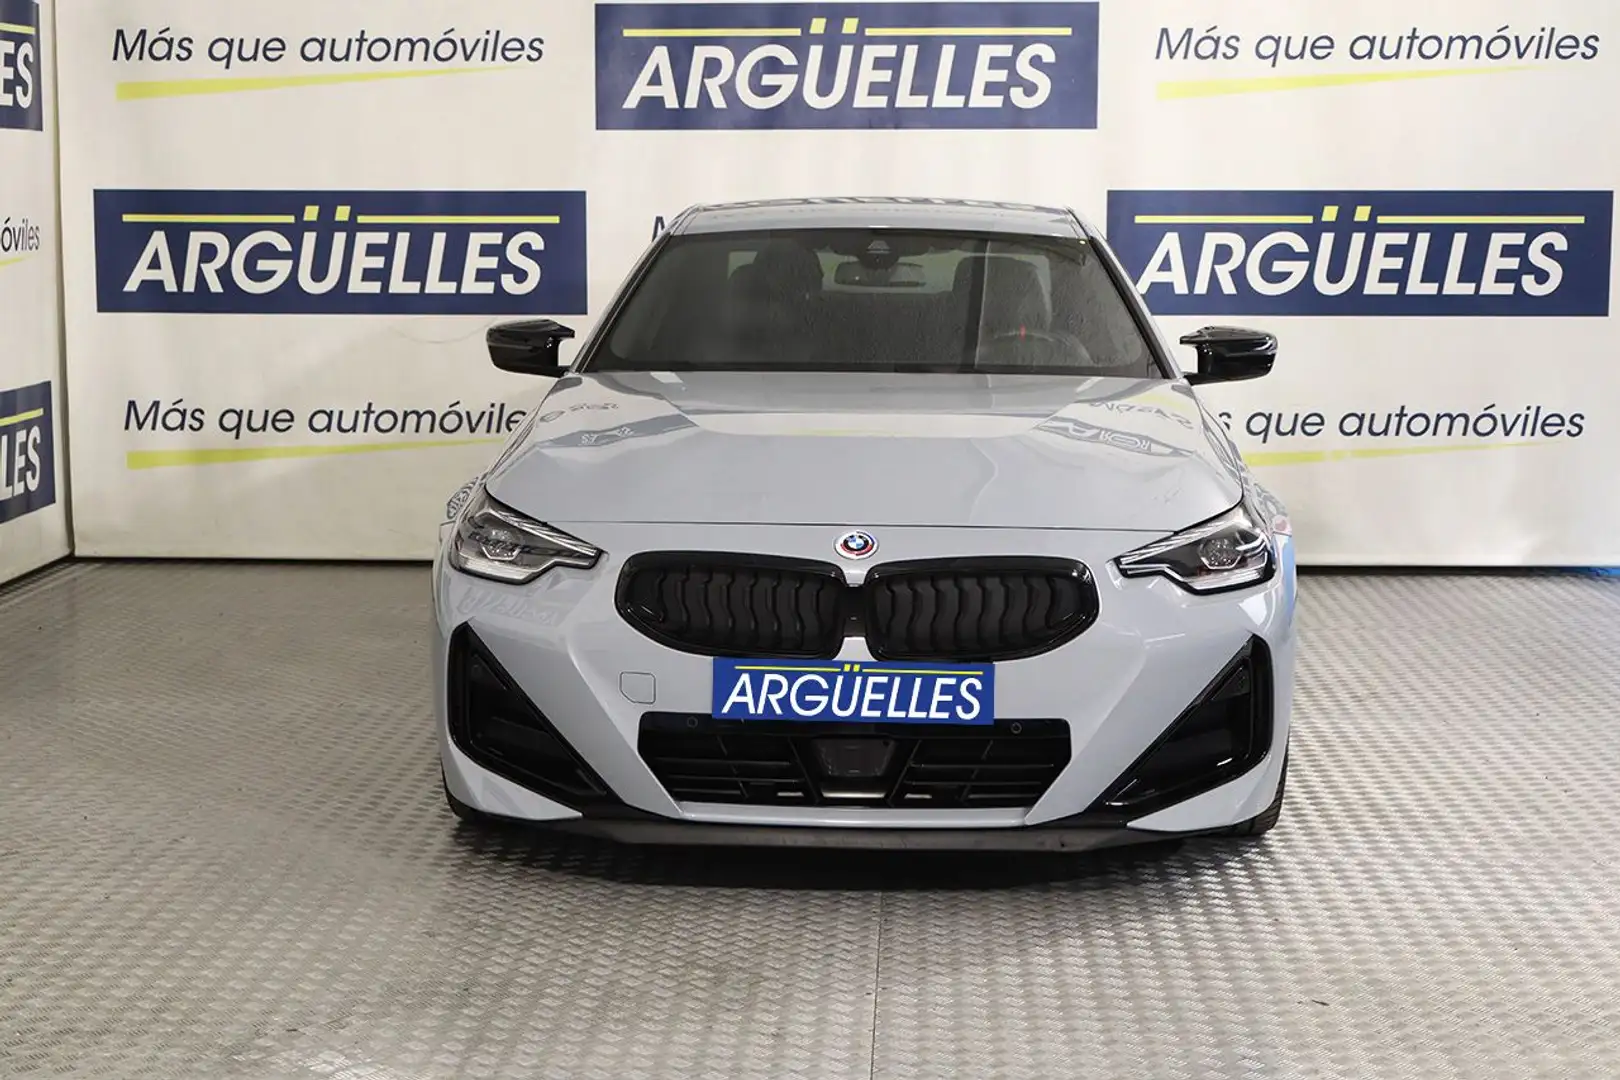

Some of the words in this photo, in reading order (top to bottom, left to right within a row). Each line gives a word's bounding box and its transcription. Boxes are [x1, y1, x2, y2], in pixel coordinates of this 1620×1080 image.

[112, 27, 194, 62] Más
[207, 38, 286, 70] que
[300, 28, 544, 62] automóviles
[622, 18, 1057, 109] ARGÜELLES
[1155, 26, 1240, 60] Más
[1255, 36, 1335, 68] que
[1349, 25, 1600, 61] automóviles
[123, 205, 546, 295] ARGÜELLES
[1135, 205, 1568, 297] ARGÜELLES
[124, 399, 205, 432] Más
[218, 409, 295, 441] que
[307, 401, 527, 435] automóvile
[1245, 412, 1325, 444] que
[1338, 403, 1585, 438] automóviles
[721, 663, 983, 721] ARGÜELLES
